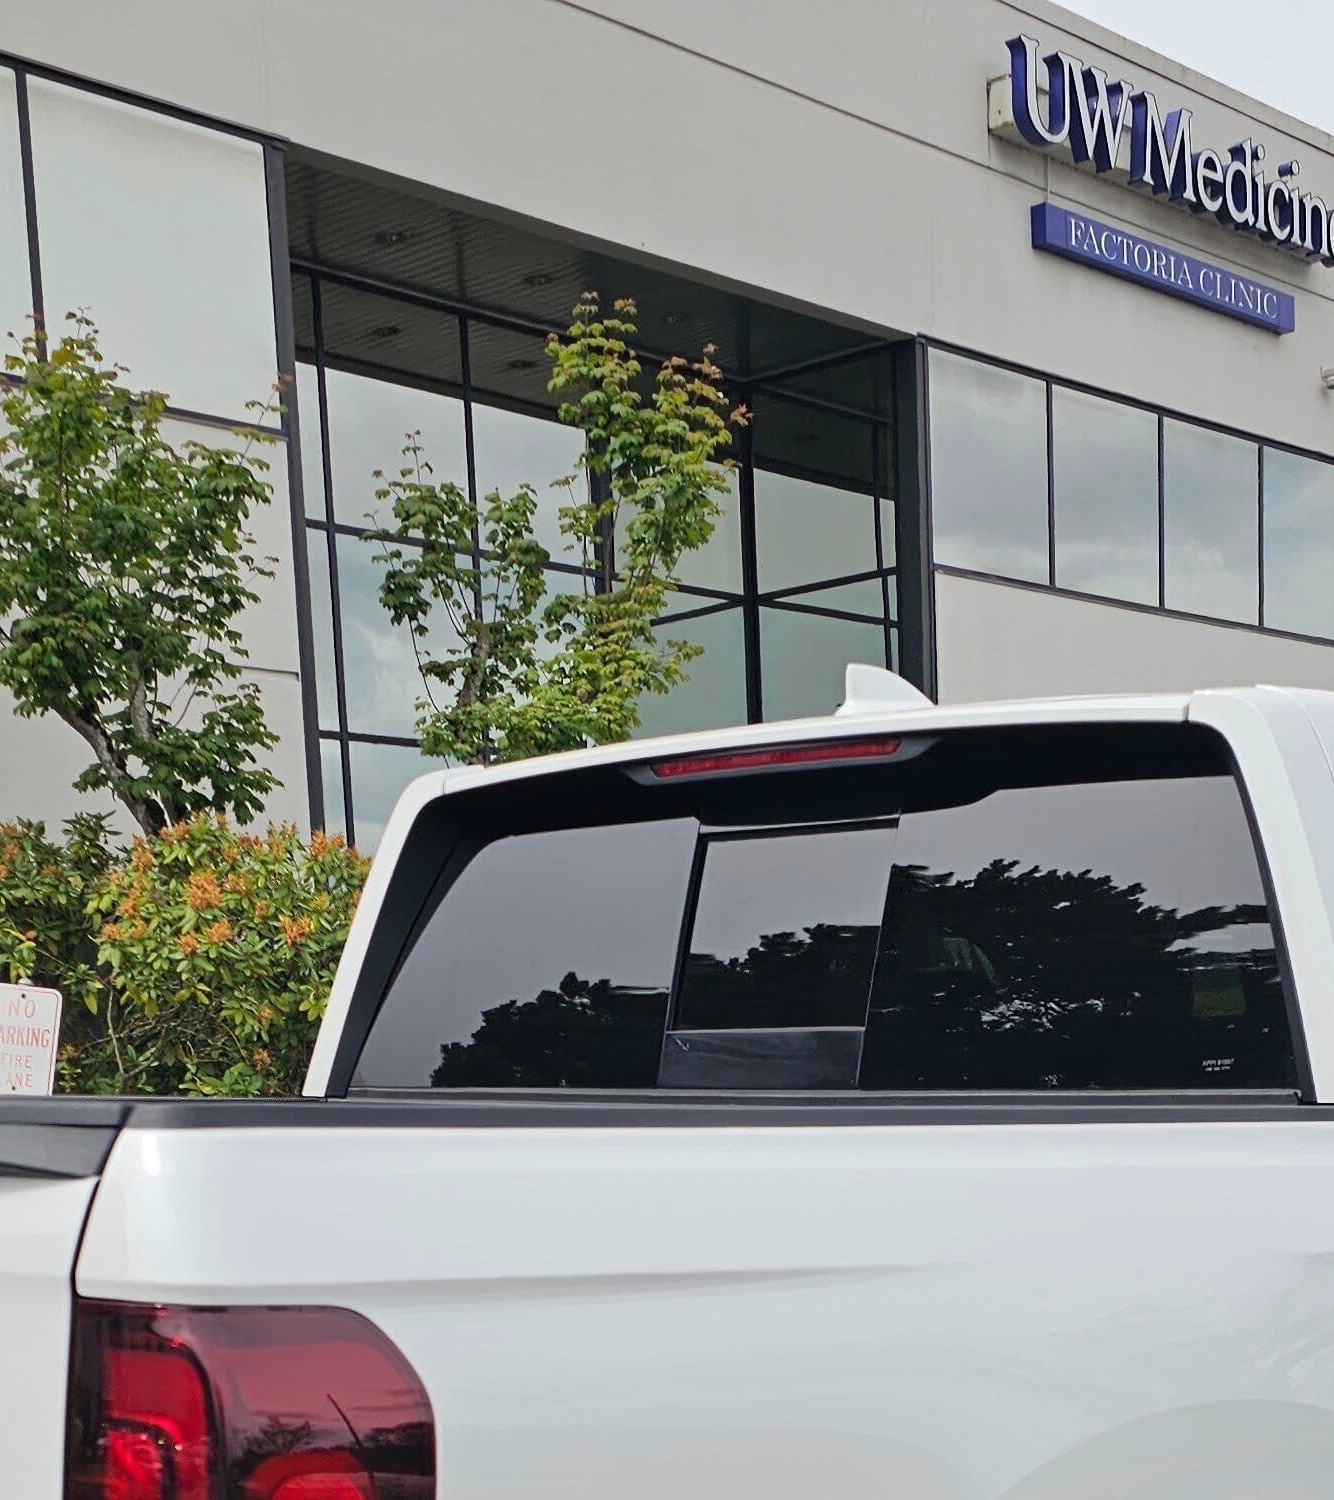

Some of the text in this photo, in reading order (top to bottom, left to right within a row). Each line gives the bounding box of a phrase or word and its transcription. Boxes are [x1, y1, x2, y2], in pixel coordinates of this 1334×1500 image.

[1006, 34, 1133, 174] UW
[1070, 217, 1279, 320] FACTORIA CLINIC
[8, 999, 35, 1018] NO
[1, 1052, 32, 1069] FIRE
